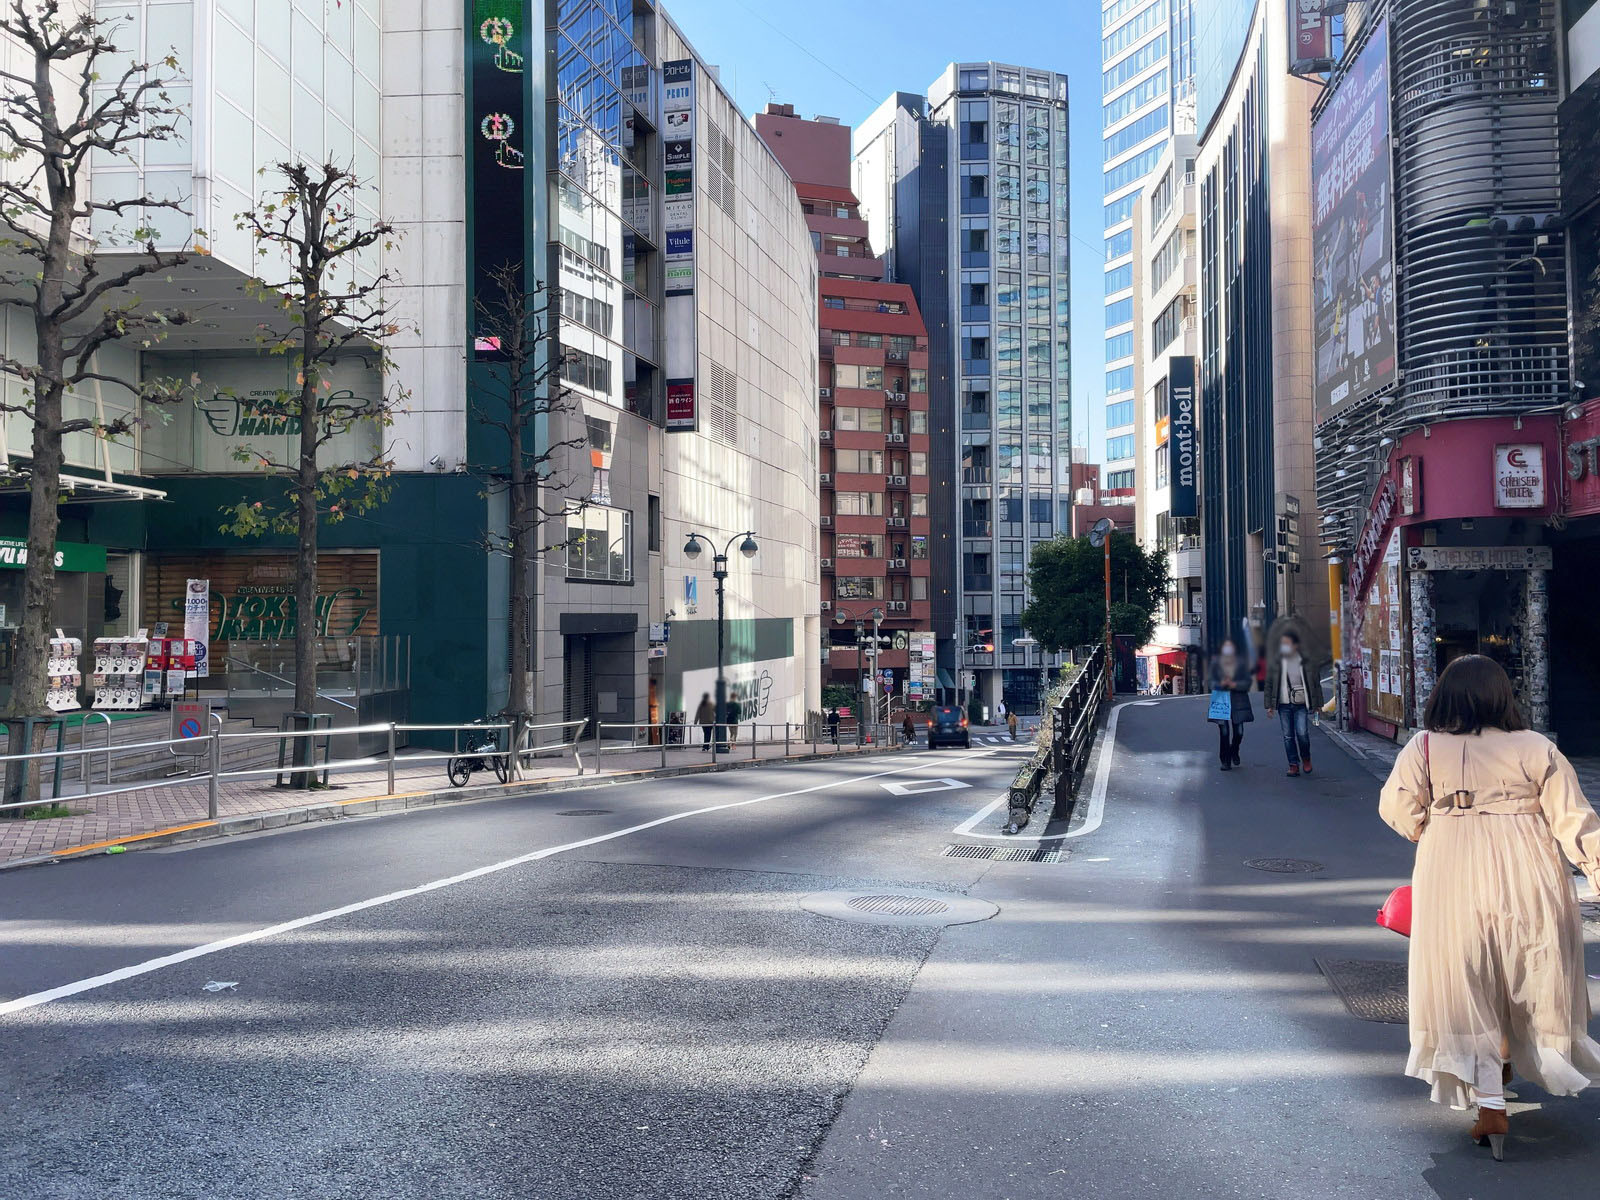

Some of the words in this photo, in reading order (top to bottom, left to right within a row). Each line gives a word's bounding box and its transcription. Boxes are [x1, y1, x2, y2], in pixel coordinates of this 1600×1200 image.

[665, 66, 690, 76] プロトビル
[1367, 63, 1383, 98] 2022
[1317, 143, 1344, 226] 無料
